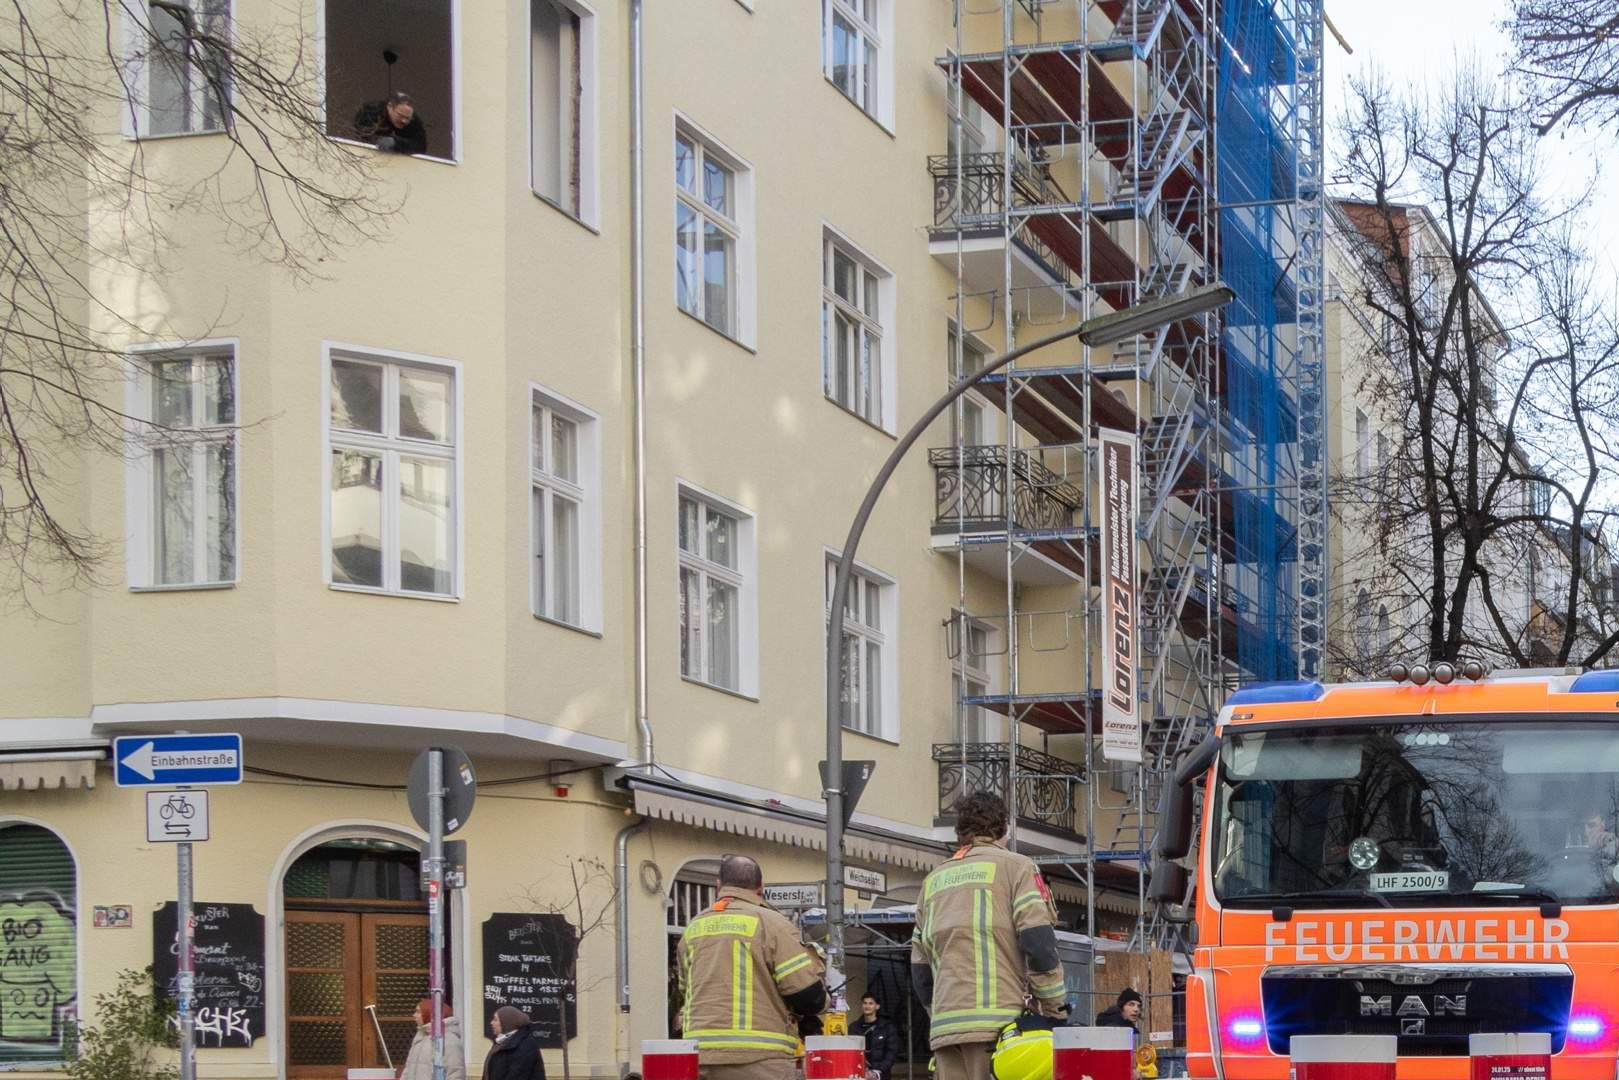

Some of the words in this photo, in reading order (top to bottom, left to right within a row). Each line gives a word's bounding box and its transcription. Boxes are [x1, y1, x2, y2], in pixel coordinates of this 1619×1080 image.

[1109, 580, 1133, 718] Lorenz
[151, 754, 234, 768] Einbahnstraße
[1377, 877, 1398, 889] LHF
[1402, 876, 1445, 889] 2500/9
[2, 917, 44, 944] BIO
[1264, 918, 1570, 962] FEUERWEHR
[1359, 995, 1467, 1017] MAN
